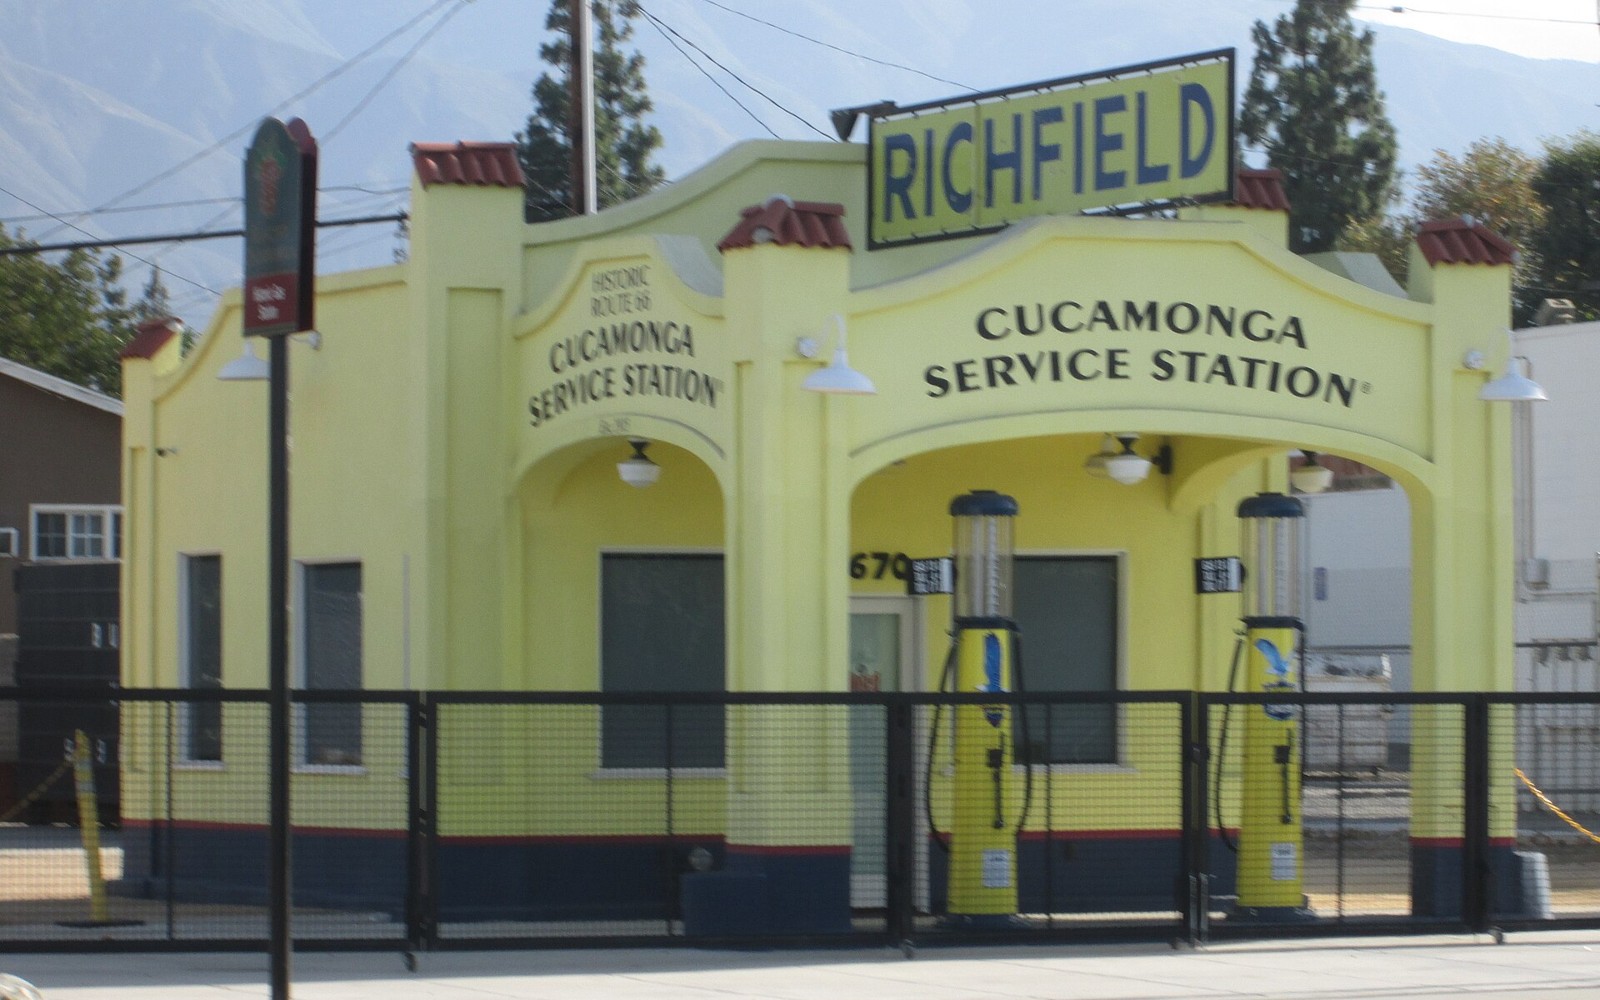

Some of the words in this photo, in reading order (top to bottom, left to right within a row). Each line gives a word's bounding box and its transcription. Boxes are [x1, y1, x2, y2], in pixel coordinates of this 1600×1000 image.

[883, 82, 1215, 223] RICHFIELD
[550, 320, 695, 374] CUCAMONGA
[976, 300, 1308, 349] CUCAMONGA
[529, 368, 615, 427] SERVICE
[623, 364, 718, 408] STATION
[924, 348, 1129, 398] SERVICE
[1149, 349, 1358, 408] STATION
